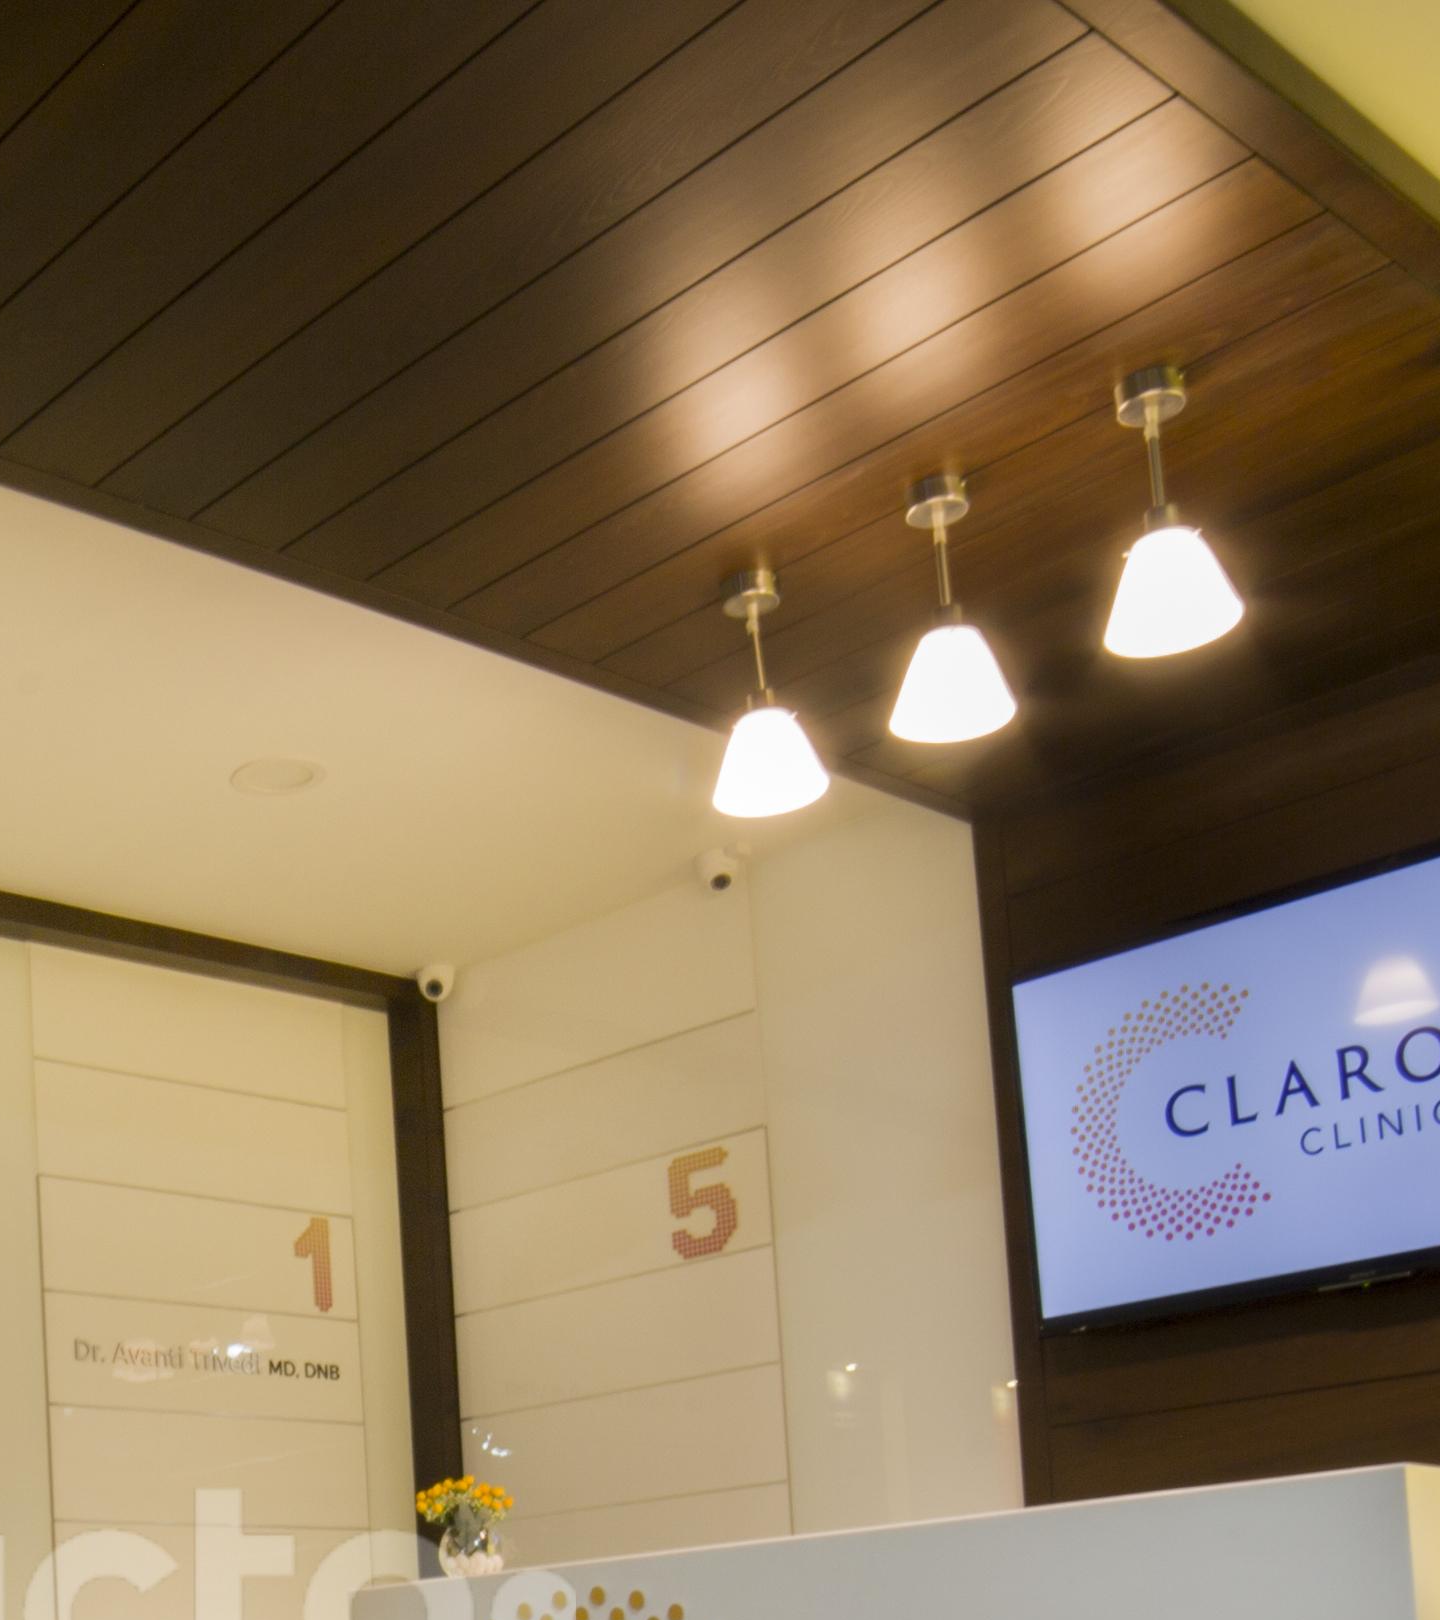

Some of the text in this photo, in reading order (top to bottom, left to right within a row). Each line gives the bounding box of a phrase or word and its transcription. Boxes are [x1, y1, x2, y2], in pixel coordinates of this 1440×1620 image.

[667, 1146, 738, 1261] 5
[293, 1216, 333, 1313] 1
[73, 1337, 105, 1363] Dr.
[267, 1359, 300, 1380] MD,
[304, 1362, 340, 1381] DNB
